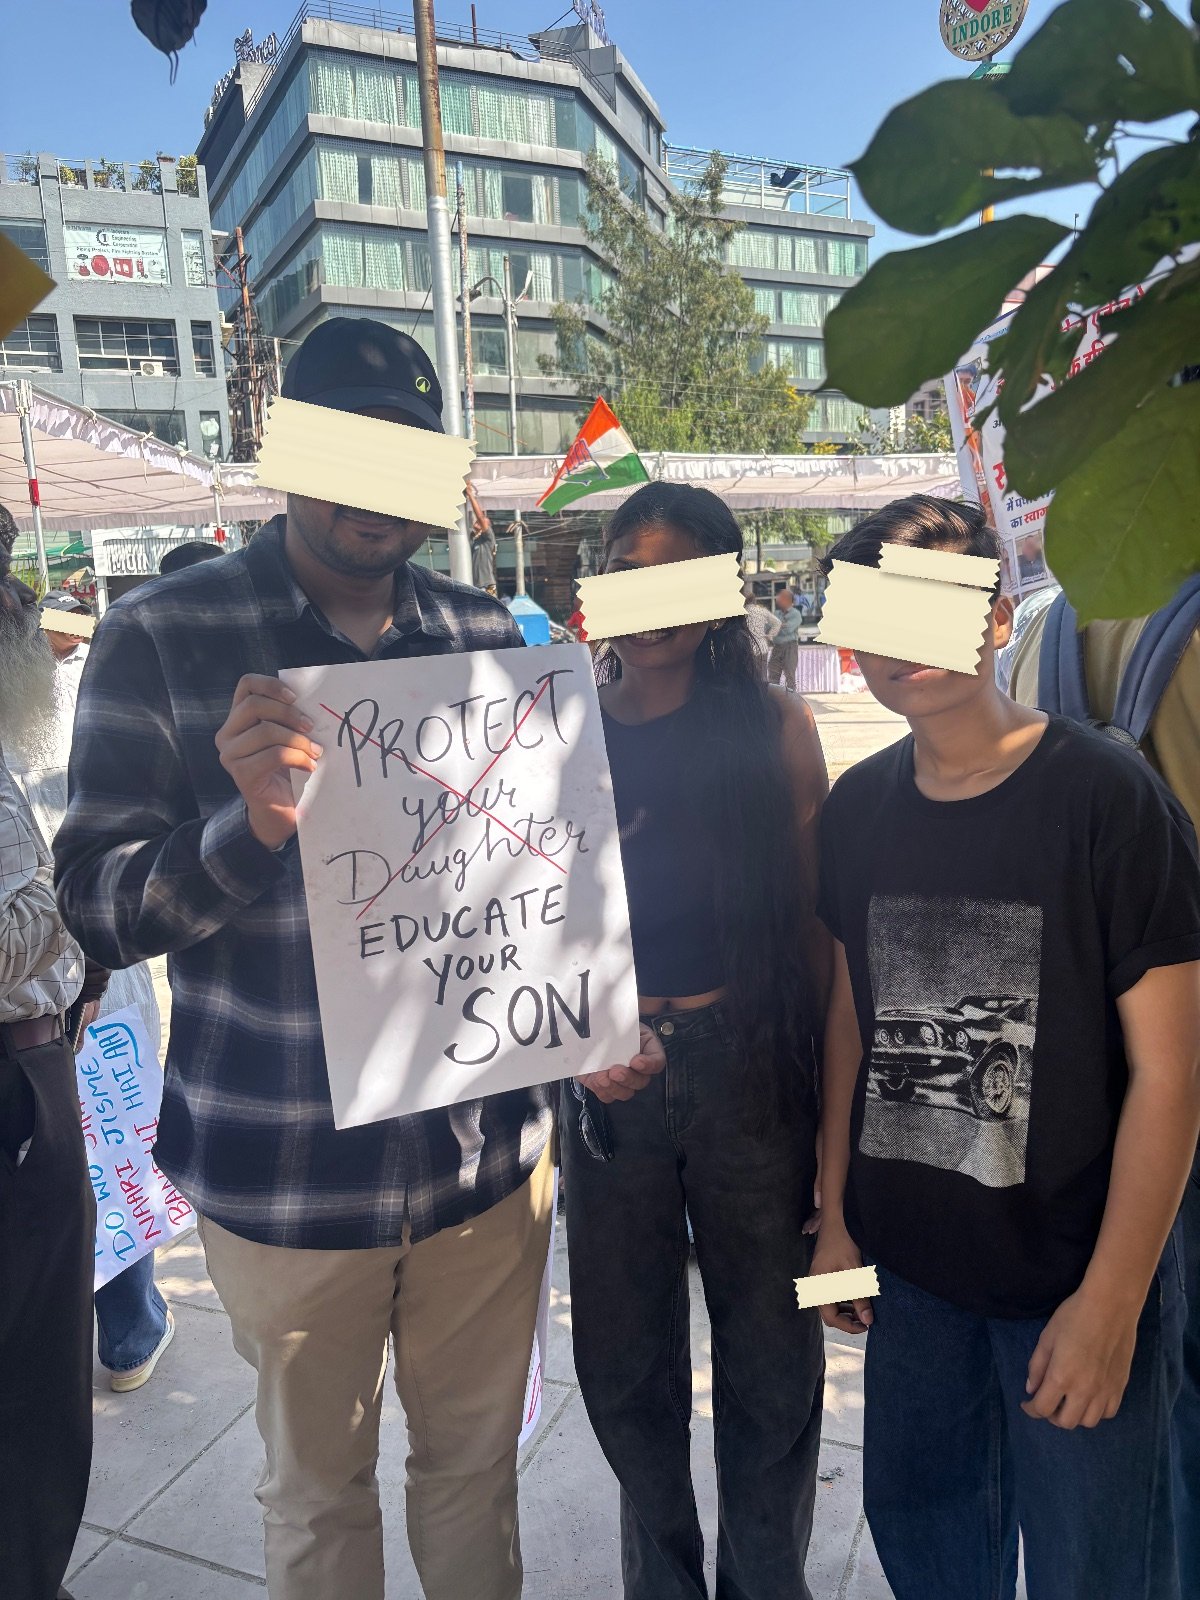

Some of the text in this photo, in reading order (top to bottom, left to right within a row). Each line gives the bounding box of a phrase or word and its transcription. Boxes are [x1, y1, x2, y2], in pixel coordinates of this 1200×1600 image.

[951, 4, 1013, 46] INDORE
[1010, 516, 1023, 528] का
[338, 669, 574, 788] PROTECT
[402, 778, 517, 853] your
[326, 812, 590, 905] Daughter
[359, 884, 566, 960] EDUCATE
[422, 944, 522, 1006] YOUR
[88, 1022, 144, 1069] AAJ
[443, 968, 592, 1065] SON
[111, 1063, 145, 1111] HAI
[80, 1056, 162, 1241] NAARI JISME
[104, 1211, 137, 1261] DO
